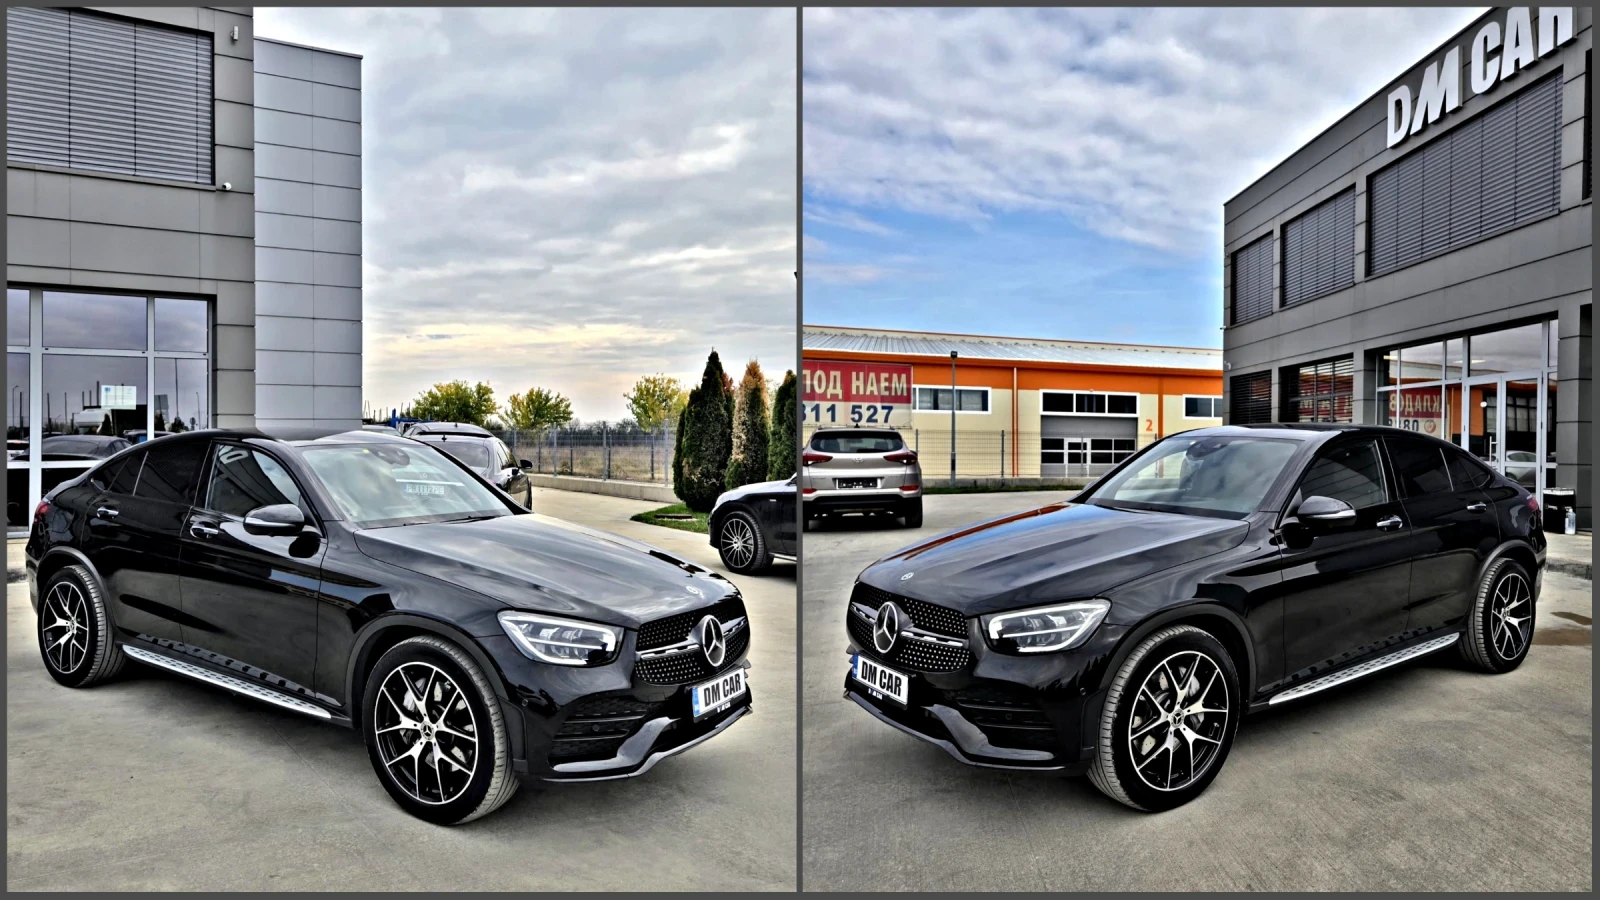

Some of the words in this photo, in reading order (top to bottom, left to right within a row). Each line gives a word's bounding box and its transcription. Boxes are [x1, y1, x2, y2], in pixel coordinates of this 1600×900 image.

[1387, 45, 1461, 149] DM
[852, 371, 907, 395] НАЕМ
[851, 404, 893, 423] 527
[1145, 418, 1153, 432] 2
[704, 682, 720, 707] DM
[723, 673, 741, 698] CAR
[861, 660, 877, 685] DM
[879, 669, 902, 697] CAR
